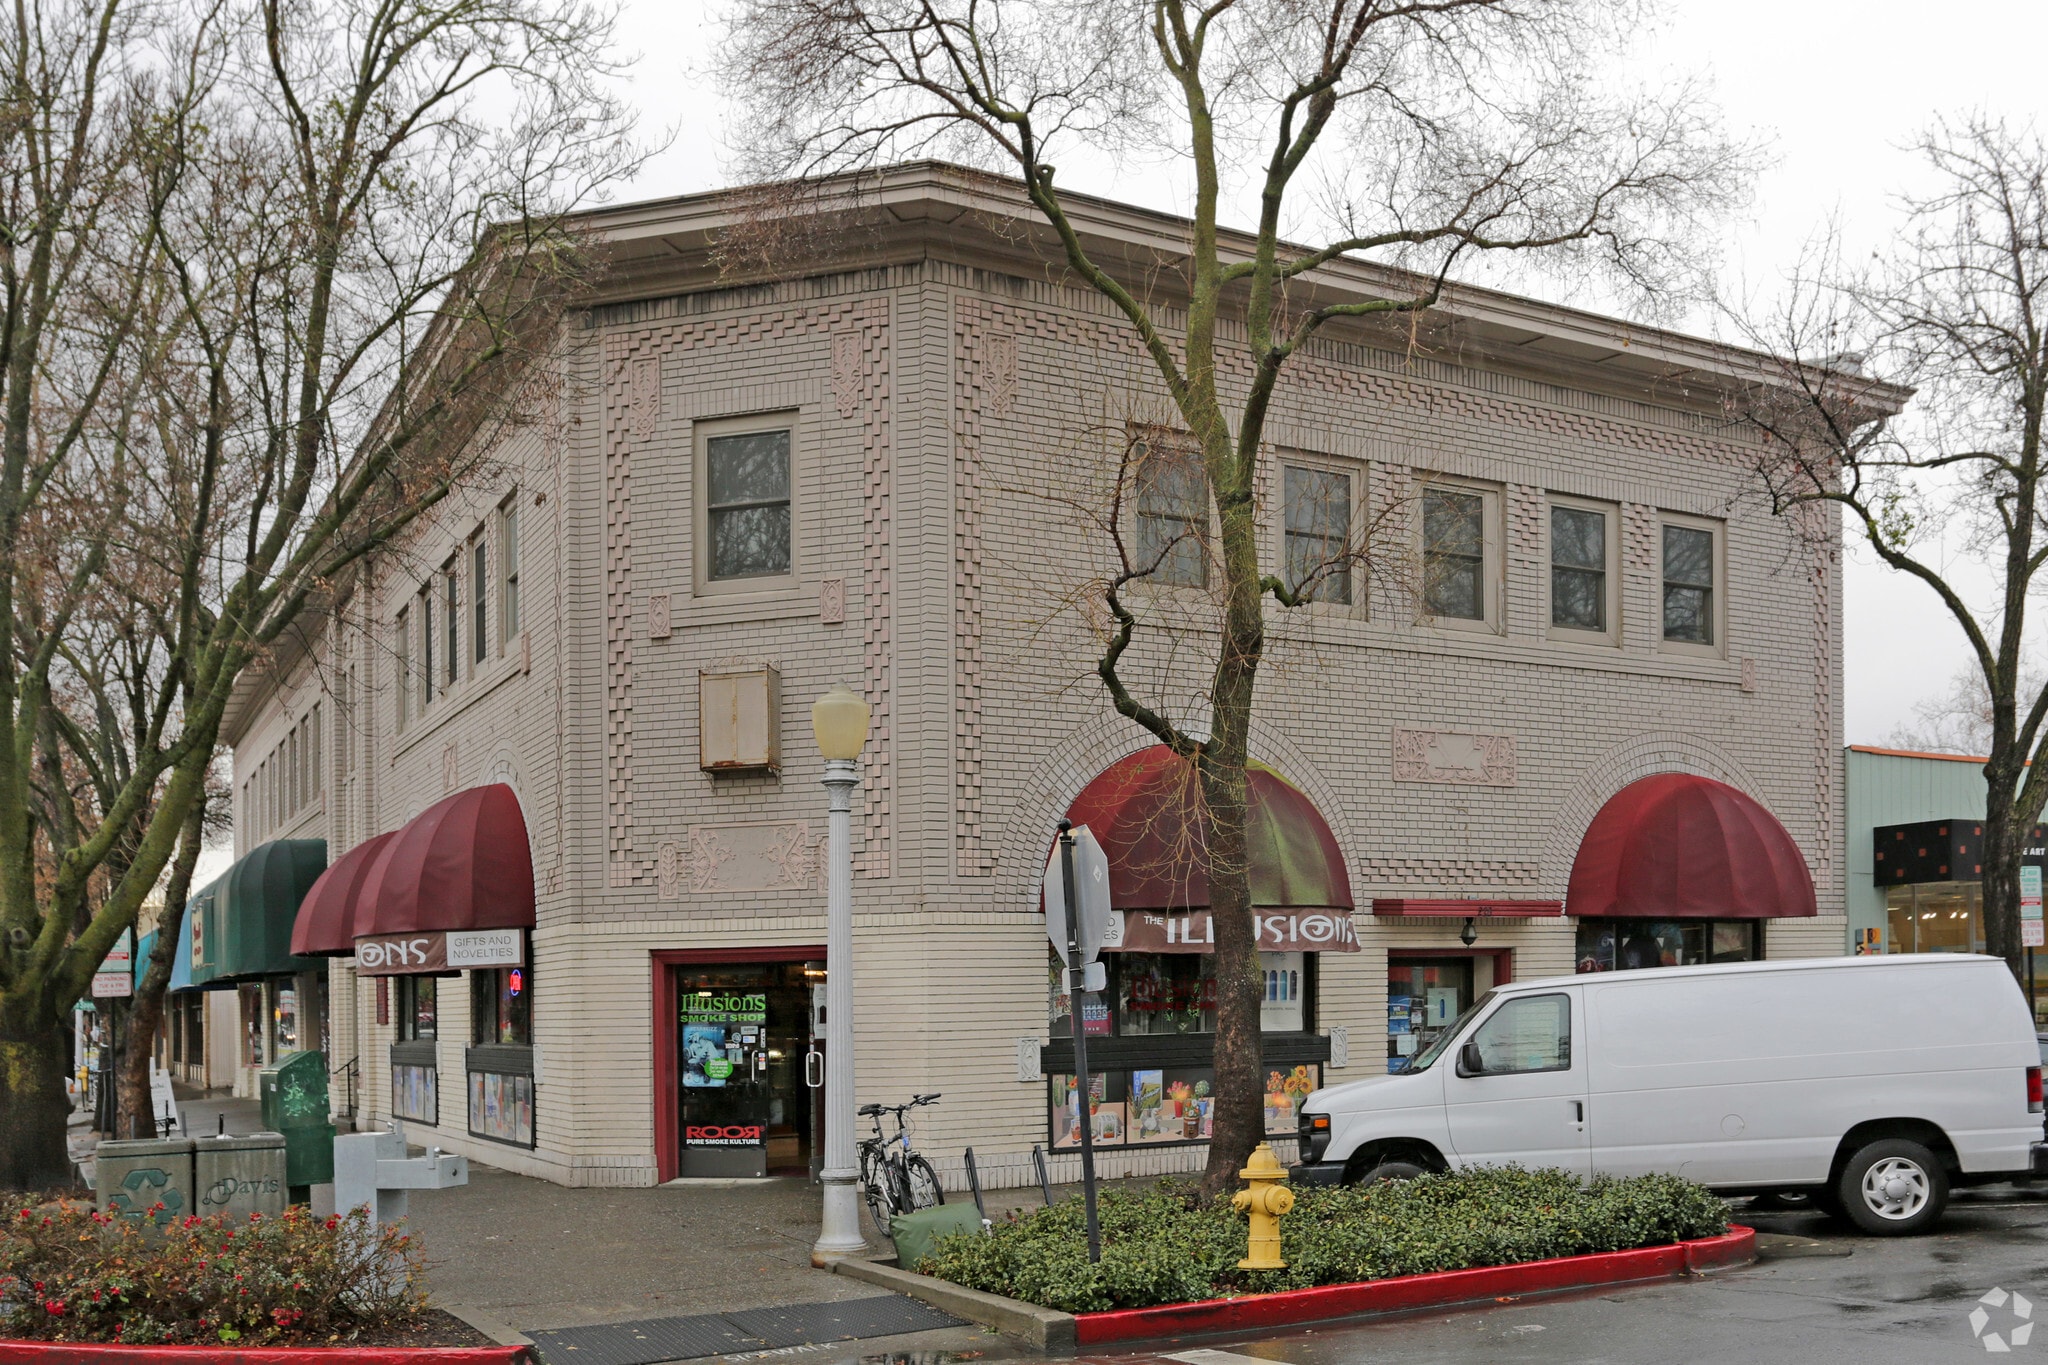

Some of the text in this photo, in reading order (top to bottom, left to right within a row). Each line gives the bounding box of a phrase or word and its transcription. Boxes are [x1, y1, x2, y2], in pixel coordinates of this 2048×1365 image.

[2029, 847, 2046, 856] ART
[1143, 914, 1361, 947] THE ILLSIONS
[454, 936, 512, 947] GIFTS AND
[453, 948, 513, 959] NOVELTIES
[1131, 975, 1217, 998] Illusion
[681, 993, 766, 1012] Illusions
[680, 1013, 767, 1023] SMOKE SHOP
[222, 1174, 279, 1196] Davis
